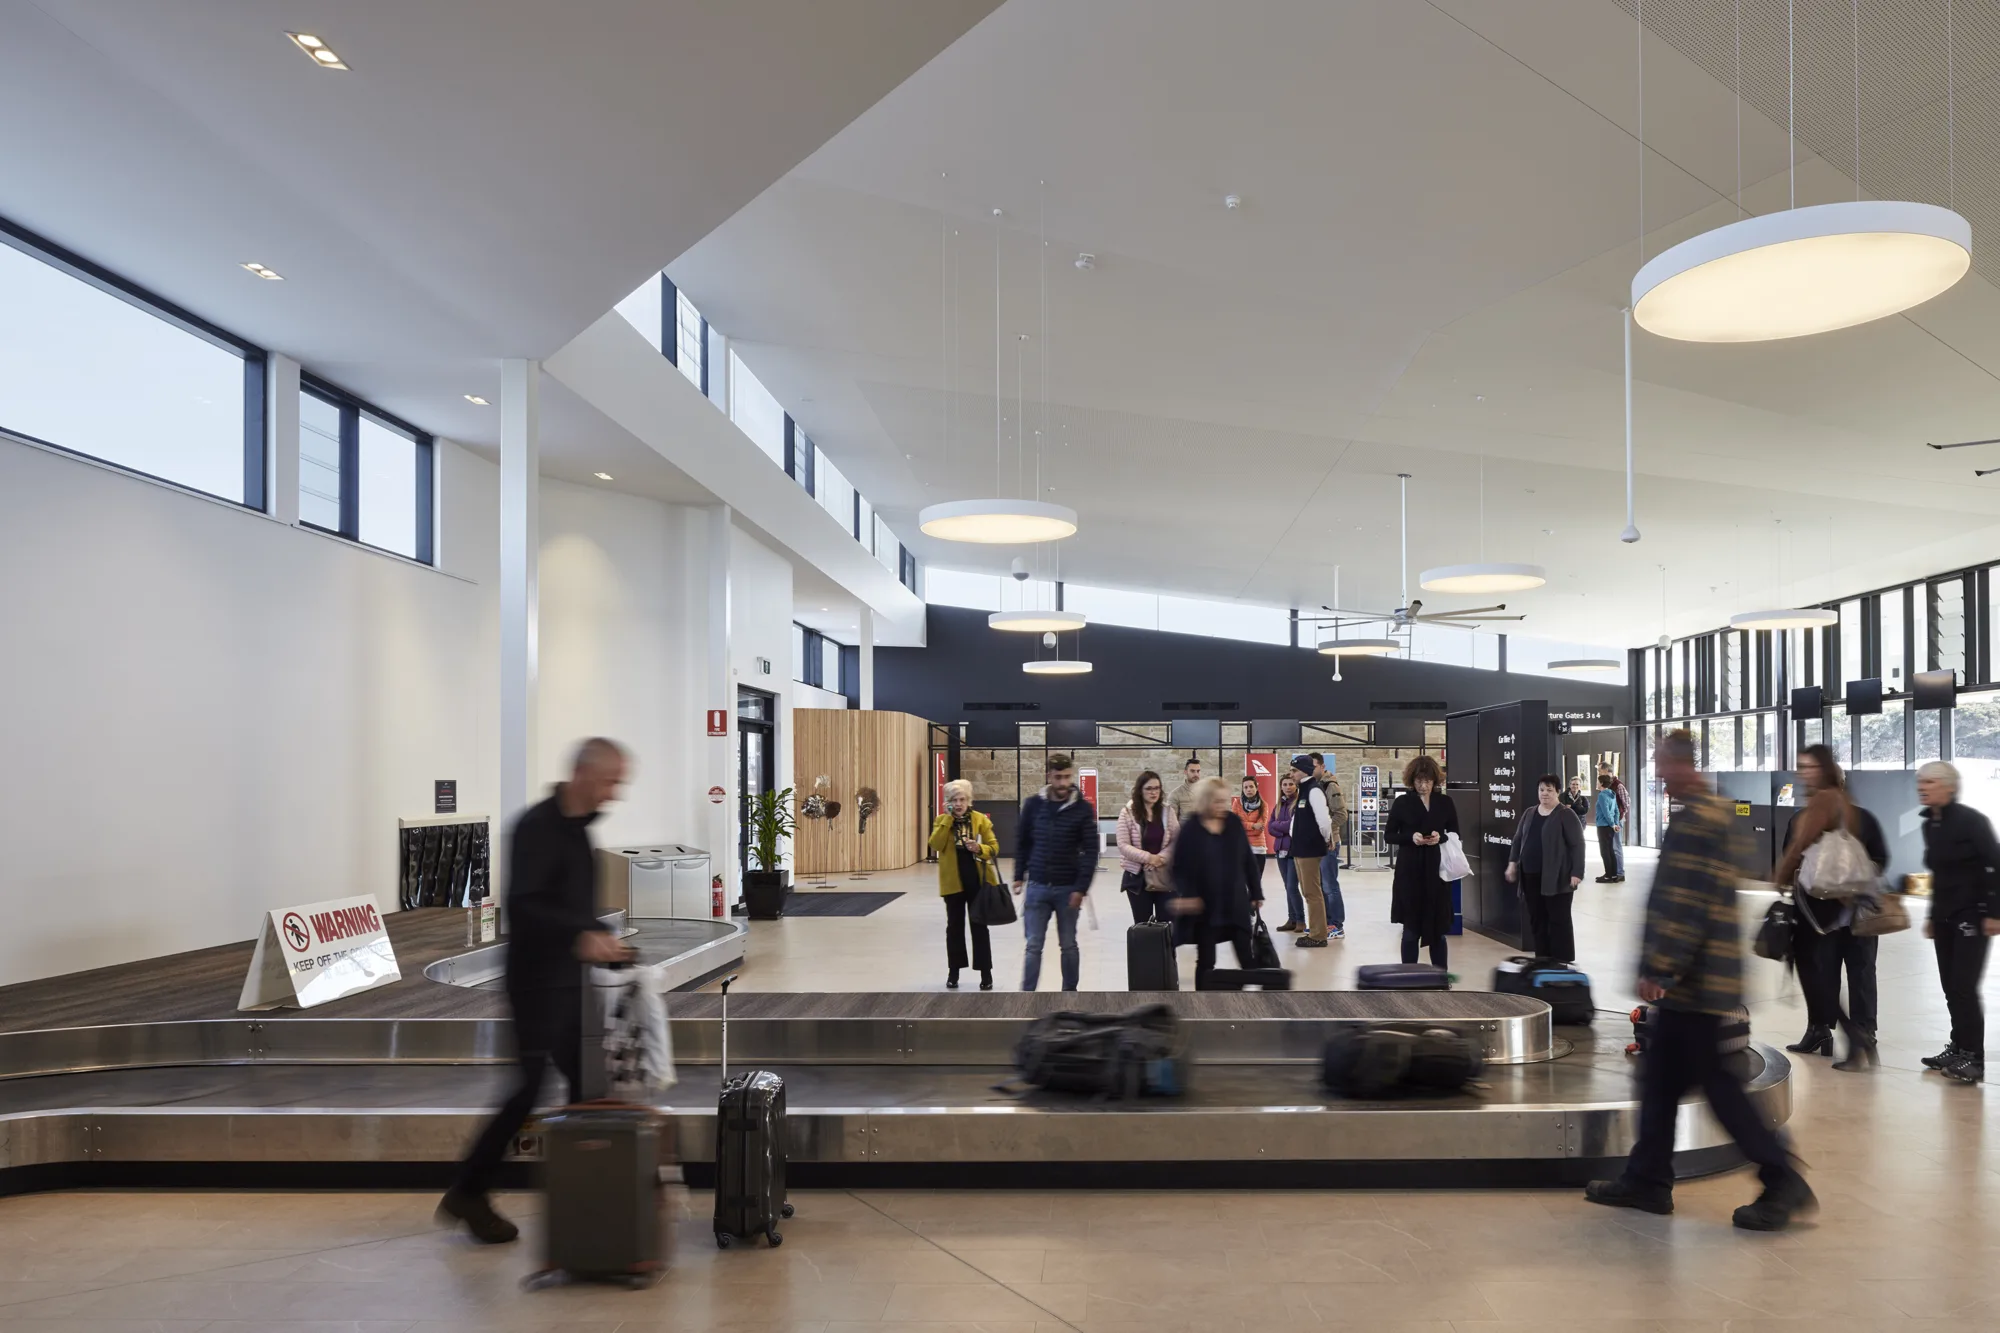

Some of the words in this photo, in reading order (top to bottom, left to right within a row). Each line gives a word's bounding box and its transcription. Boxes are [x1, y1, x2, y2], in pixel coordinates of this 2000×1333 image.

[309, 904, 381, 944] WARNING
[293, 958, 314, 972] KEEP
[316, 954, 332, 967] OFF
[333, 949, 349, 962] THE
